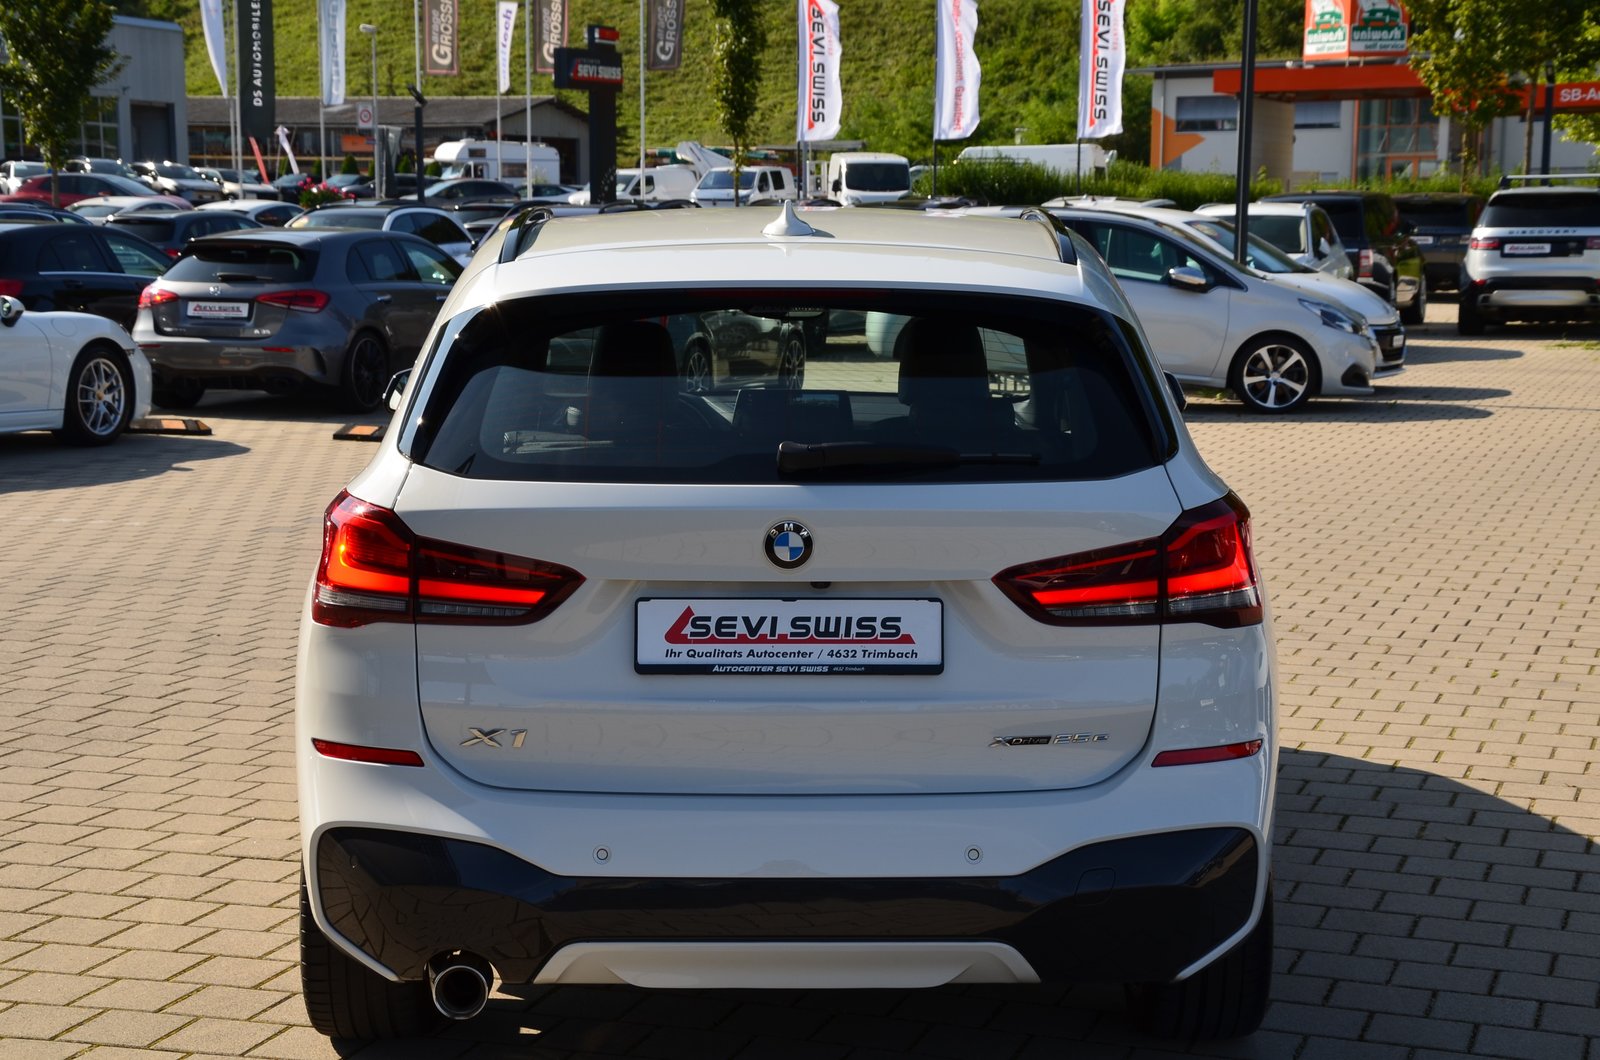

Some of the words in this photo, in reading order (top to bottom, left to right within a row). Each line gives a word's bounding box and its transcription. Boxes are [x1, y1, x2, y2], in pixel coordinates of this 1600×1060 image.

[431, 0, 453, 65] GROSS
[542, 0, 562, 65] GROSS
[812, 7, 825, 56] SEVI
[1097, 0, 1111, 50] SEVI
[1307, 29, 1345, 42] uniwash
[1353, 28, 1401, 40] uniwash
[250, 0, 263, 87] AUTOMOBILE
[252, 90, 263, 107] DS
[812, 62, 825, 123] SWISS
[1094, 57, 1108, 120] SWISS
[1560, 87, 1600, 102] SB-A
[770, 522, 810, 538] BMW
[689, 616, 778, 638] SEVI
[790, 616, 902, 638] SWISS
[665, 649, 682, 658] Ihr
[686, 648, 742, 659] Qualitats
[747, 648, 813, 658] Autocenter
[827, 649, 857, 658] 4632
[861, 648, 918, 659] Trimbach
[459, 727, 528, 748] X1
